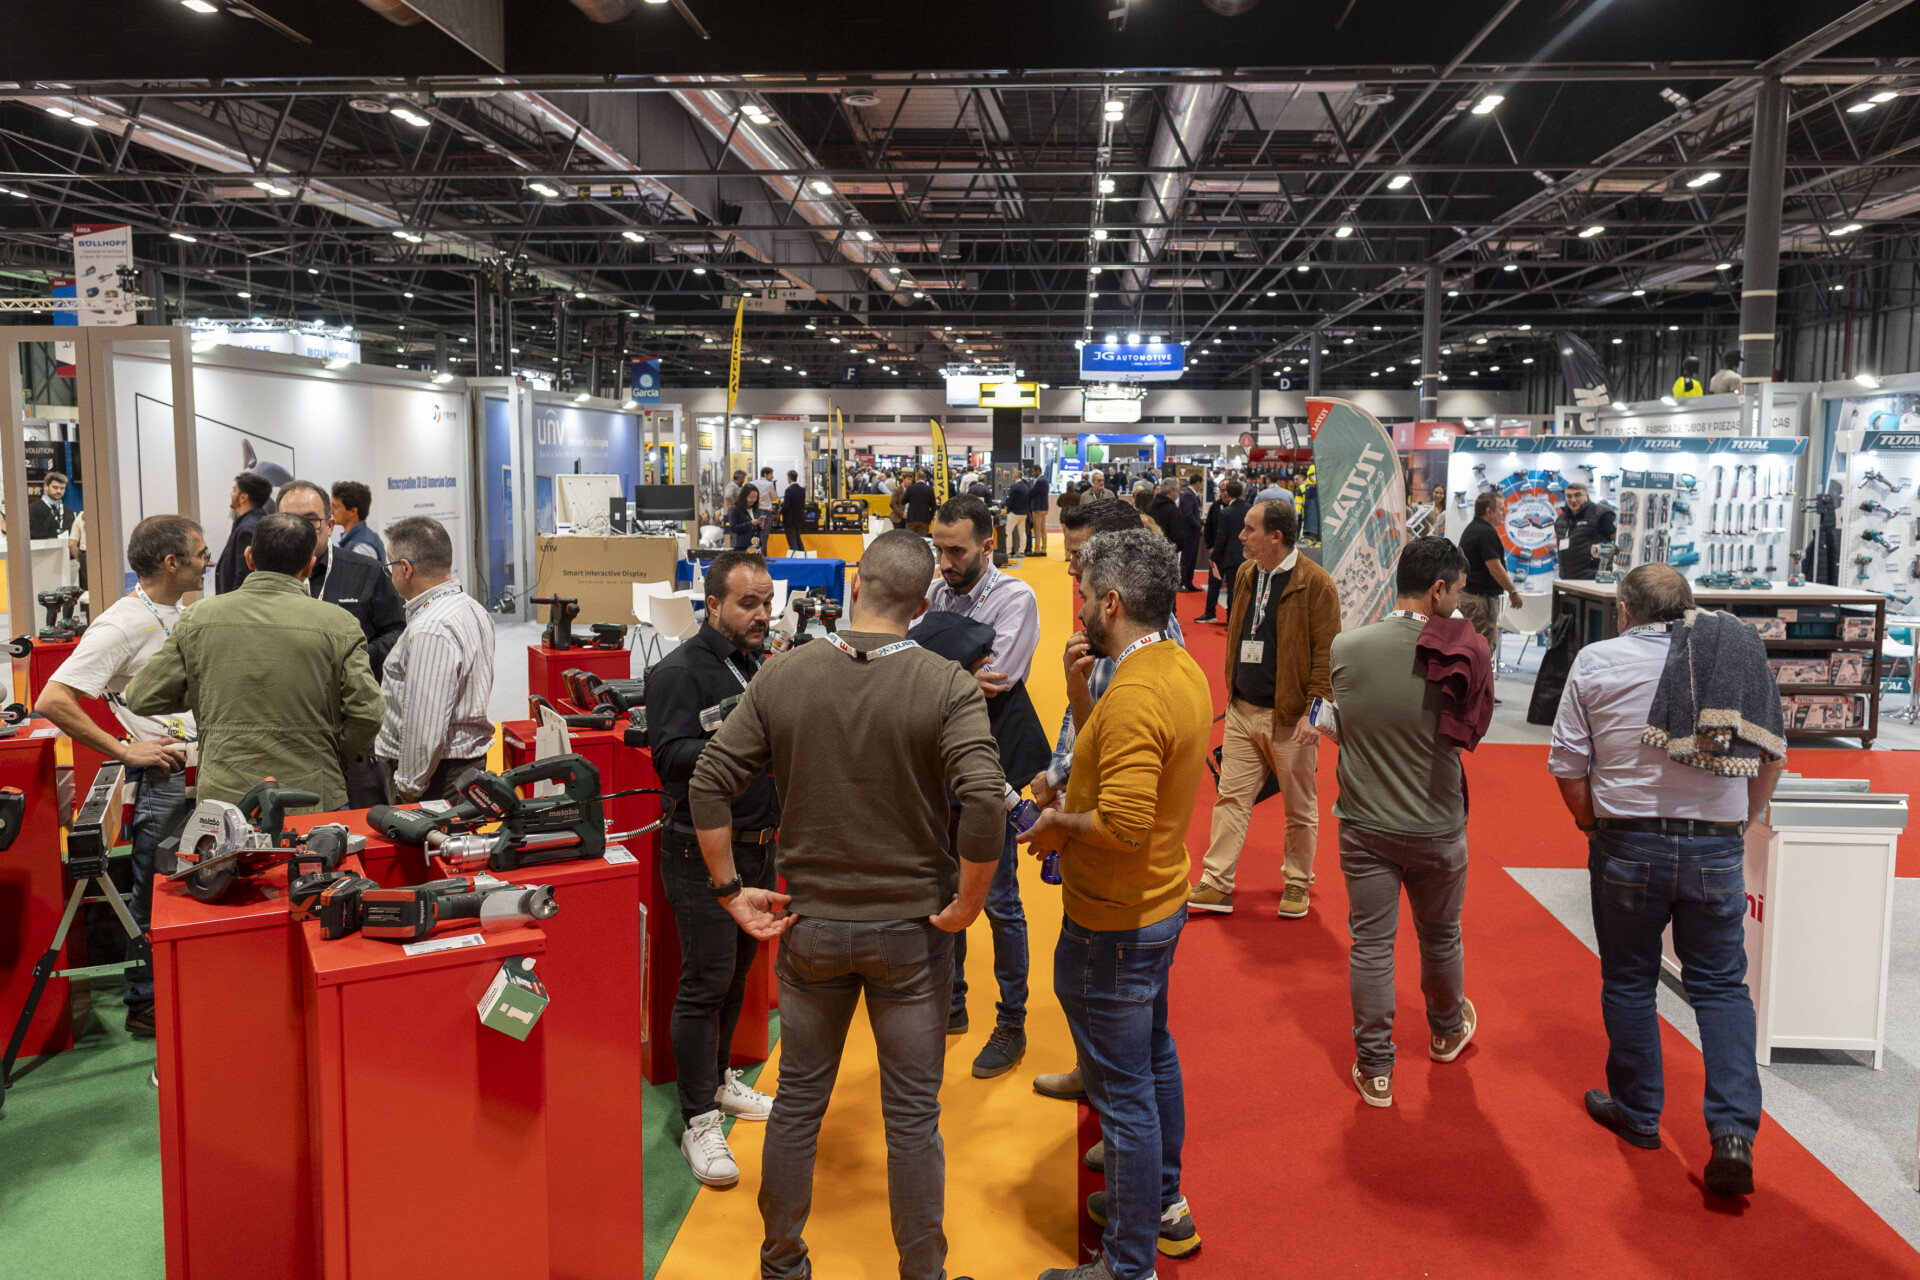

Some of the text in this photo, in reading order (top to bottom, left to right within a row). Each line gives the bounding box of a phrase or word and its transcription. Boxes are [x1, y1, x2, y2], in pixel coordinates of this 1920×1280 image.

[847, 368, 855, 380] F
[1280, 378, 1290, 390] D
[563, 569, 647, 578] Smart Interactive Display
[548, 808, 580, 817] metabo
